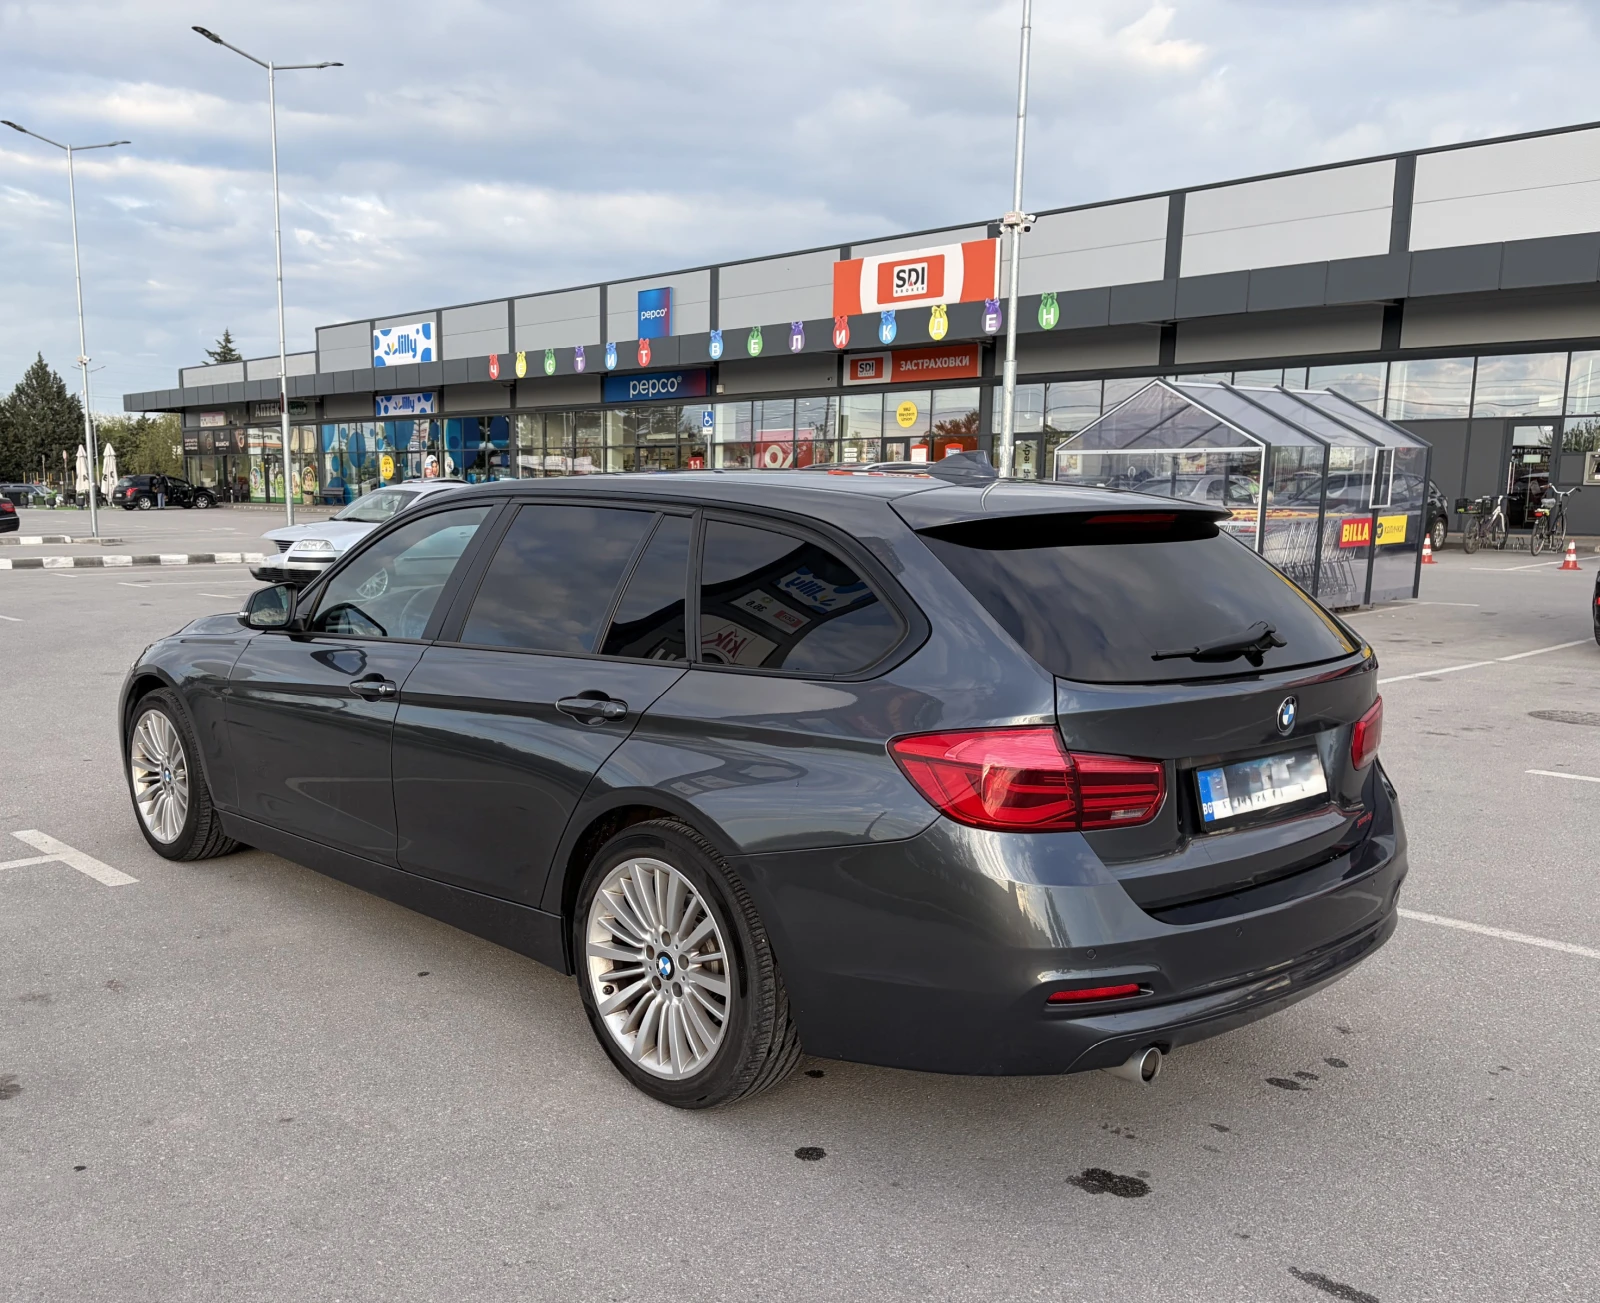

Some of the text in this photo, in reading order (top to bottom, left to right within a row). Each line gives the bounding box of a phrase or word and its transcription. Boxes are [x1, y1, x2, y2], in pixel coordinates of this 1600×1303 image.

[896, 266, 925, 288] SDI
[397, 333, 418, 359] lilly
[859, 362, 874, 373] SDI
[900, 355, 970, 372] ЗАСТРАХОВКИ
[255, 402, 281, 417] АПТЕК
[401, 396, 415, 413] lilly
[1341, 522, 1369, 543] BILLA
[1202, 802, 1213, 814] BG
